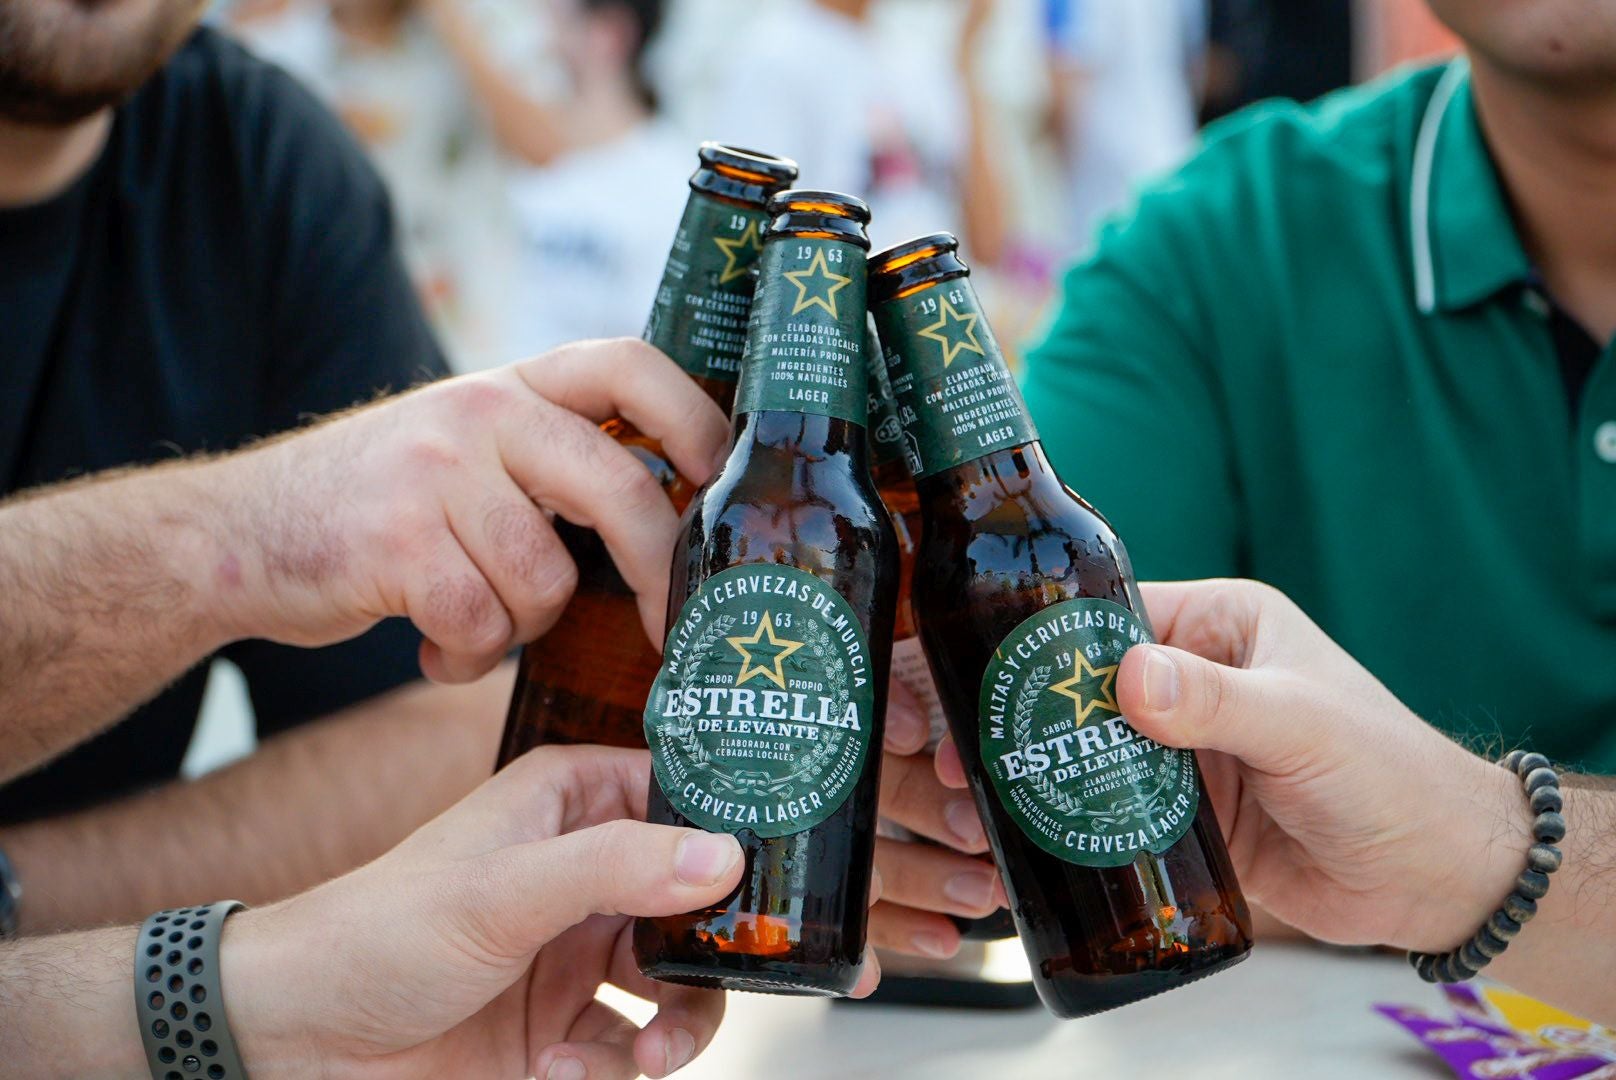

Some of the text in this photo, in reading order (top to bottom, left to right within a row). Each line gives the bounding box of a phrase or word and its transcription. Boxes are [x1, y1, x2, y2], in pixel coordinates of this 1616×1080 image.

[763, 333, 859, 353] CON CEBADAS LOCALES
[787, 323, 840, 337] ELABORADA
[771, 344, 850, 364] MALTERÍA PROPIA
[771, 371, 848, 388] 100% NATURALES
[777, 361, 844, 376] INGREDIENTES
[946, 362, 995, 385] ELABORADA
[789, 388, 829, 404] LAGER
[926, 389, 943, 405] CON
[945, 378, 985, 397] CEBADAS
[941, 389, 985, 414] MALTERÍA
[952, 408, 1021, 437] 100% NATURALES
[954, 398, 1014, 424] INGREDIENTES
[978, 426, 1014, 447] LAGER
[669, 575, 867, 688] MALTAS Y CERVEZAS DE MURCIA
[704, 674, 823, 692] SABOR PROPIO
[990, 670, 1014, 739] MALTAS
[1004, 655, 1022, 671] Y
[1016, 610, 1105, 659] CERVEZAS
[1108, 612, 1126, 634] DE
[662, 688, 861, 731] ESTRELLA
[698, 719, 820, 741] DE LEVANTE
[1042, 719, 1073, 738] SABOR
[664, 723, 688, 780] INGREDIENTES
[715, 747, 795, 762] CEBADAS LOCALES
[720, 738, 791, 752] ELABORADA CON
[1000, 715, 1139, 782] ESTRE
[661, 745, 682, 788] NATURALES
[820, 736, 855, 791] INGREDIENTES
[825, 740, 862, 800] 100% NATURALES
[1052, 763, 1082, 784] DE
[1084, 760, 1149, 788] ELABORADA CON
[1083, 768, 1156, 799] CEBADAS LOCALES
[683, 782, 824, 824] CERVEZA LAGER
[1009, 788, 1059, 842] 100% NATURALES
[1015, 784, 1063, 832] INGREDIENTES
[1065, 793, 1191, 854] CERVEZA LAGER
